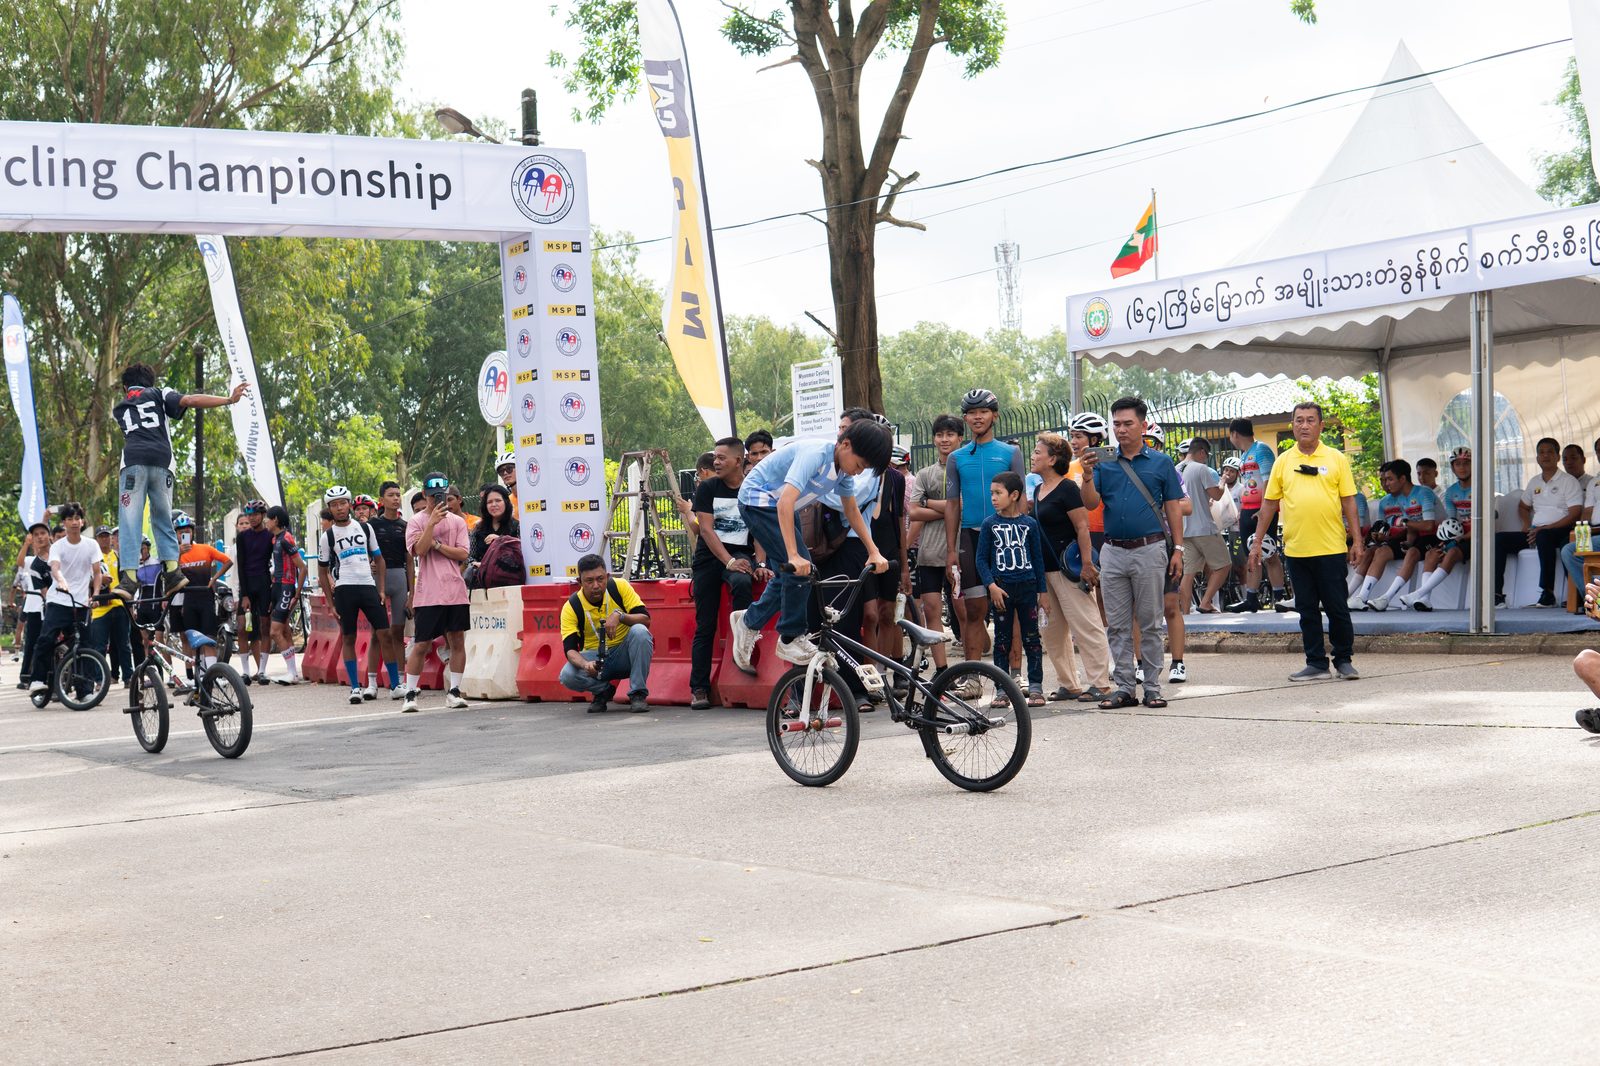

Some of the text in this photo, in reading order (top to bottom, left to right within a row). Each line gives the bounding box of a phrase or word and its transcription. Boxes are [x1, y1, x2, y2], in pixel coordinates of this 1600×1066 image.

[0, 145, 452, 210] cling Championship
[122, 400, 160, 434] 15
[565, 502, 586, 510] MSP
[336, 534, 365, 550] TYC
[992, 523, 1030, 548] STAY
[995, 546, 1032, 571] COOL
[280, 590, 291, 610] CCC
[534, 614, 561, 631] Y.C.
